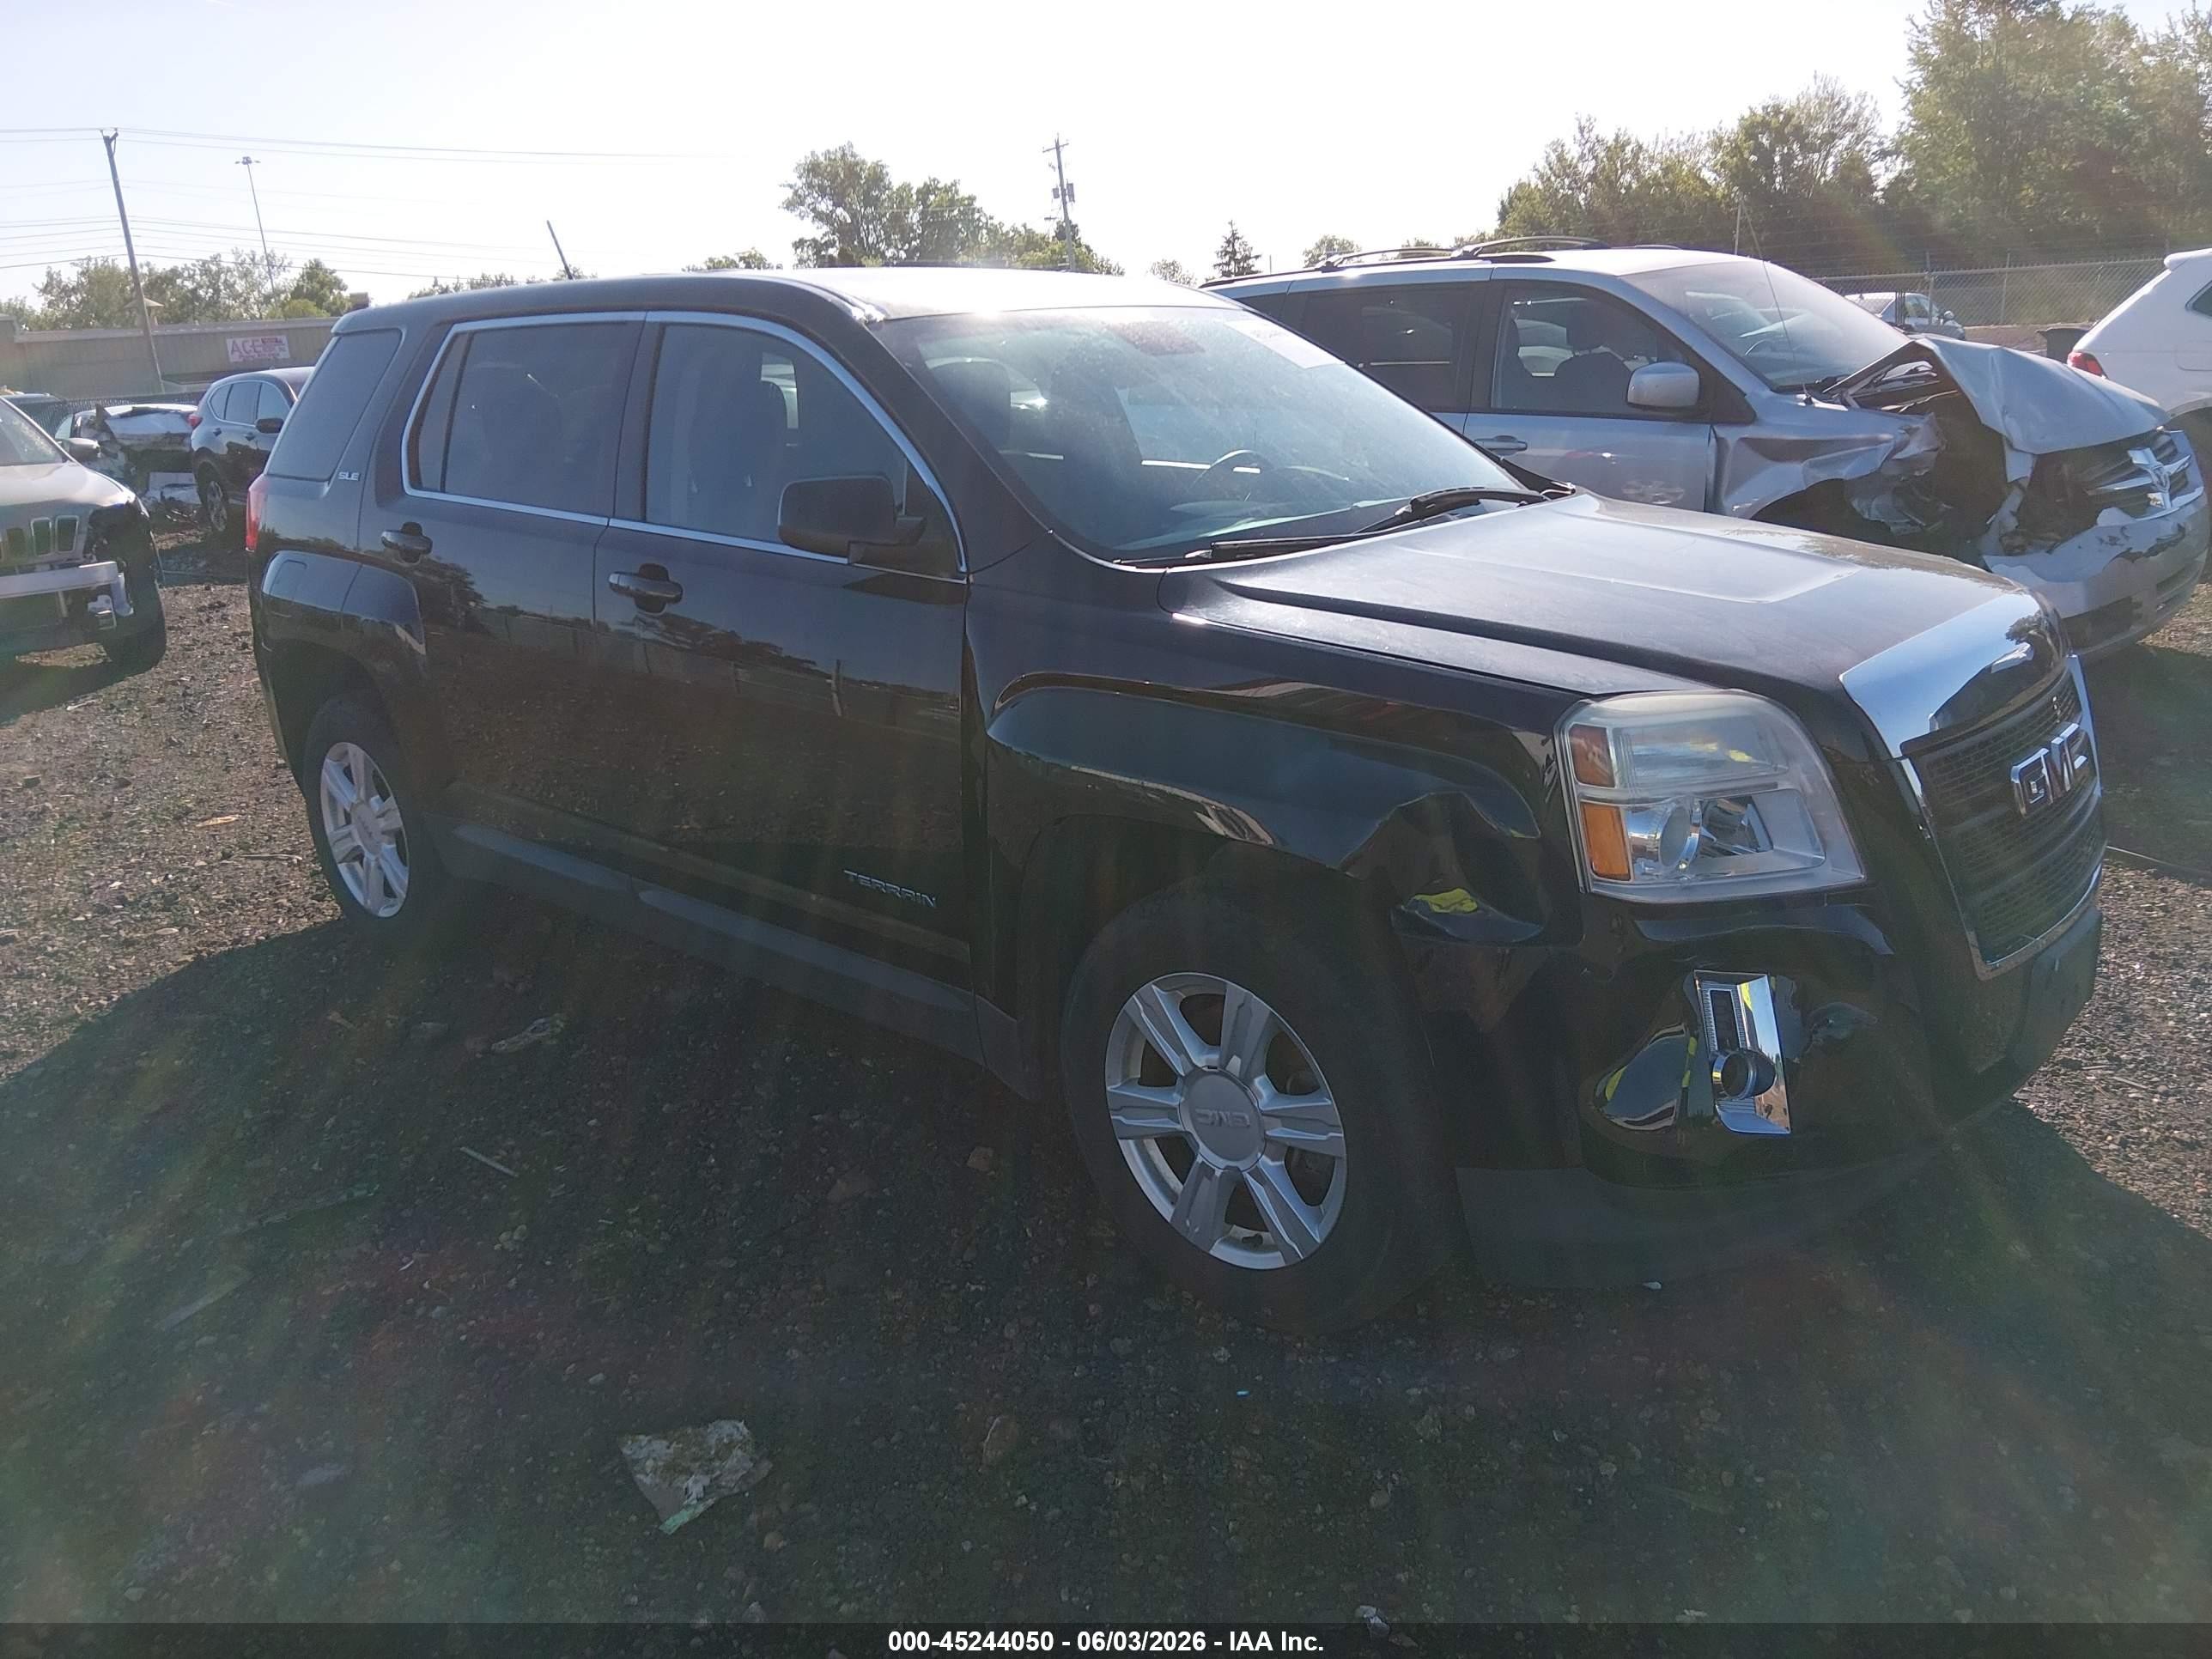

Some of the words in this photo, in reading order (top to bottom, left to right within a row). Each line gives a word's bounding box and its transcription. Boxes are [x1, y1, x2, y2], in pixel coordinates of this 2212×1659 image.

[230, 339, 262, 356] ACE
[337, 471, 360, 482] SLE
[2010, 722, 2088, 817] GMC
[843, 869, 937, 908] TERRAIN
